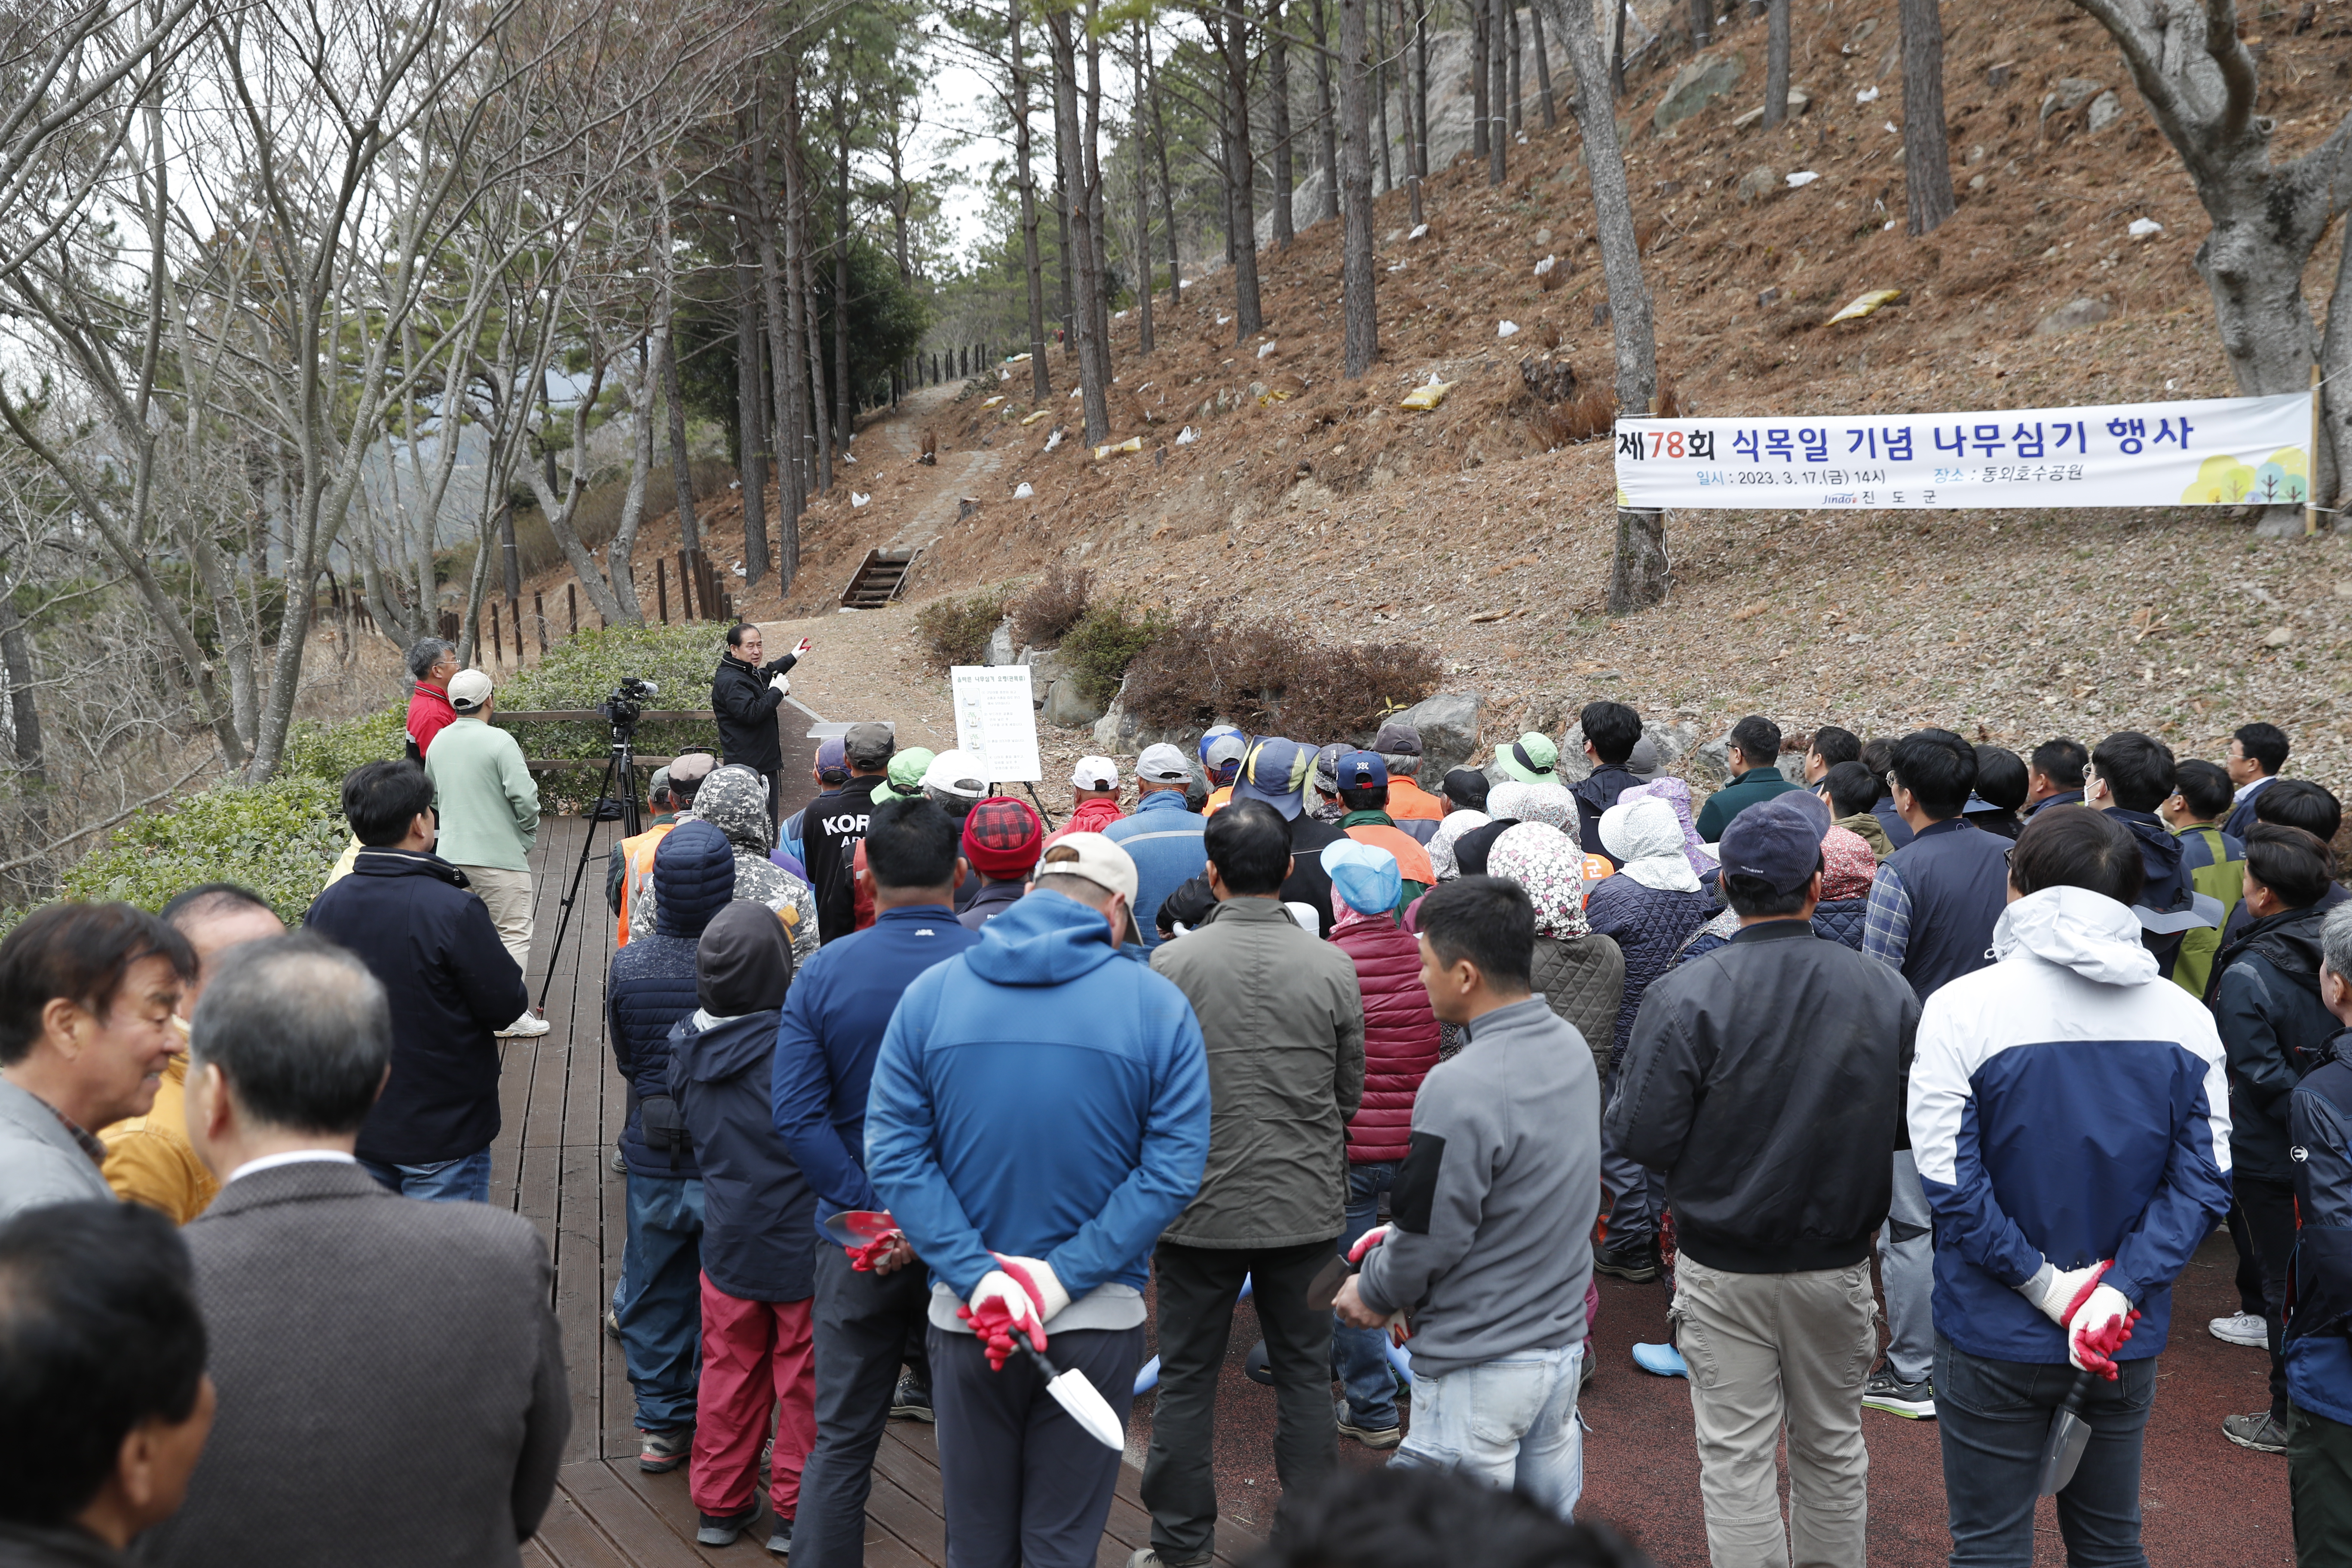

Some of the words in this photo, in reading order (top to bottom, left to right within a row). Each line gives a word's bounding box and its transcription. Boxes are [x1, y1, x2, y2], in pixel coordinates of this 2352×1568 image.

[1618, 429, 1715, 461] 제78회
[1732, 428, 1829, 462] 식목일
[1846, 426, 1913, 461] 기념
[1934, 421, 2086, 458] 나무심기
[2106, 416, 2194, 455] 행사
[1697, 471, 1724, 485] 일시
[1738, 472, 1778, 484] 2023.
[1783, 472, 1797, 484] 3.
[1802, 469, 1849, 485] 17.(금)
[1854, 469, 1885, 484] 14시
[1934, 468, 1963, 482] 장소
[1982, 465, 2083, 483] 동외호수공원
[1822, 494, 1852, 505] Jindo
[822, 814, 870, 836] KOR
